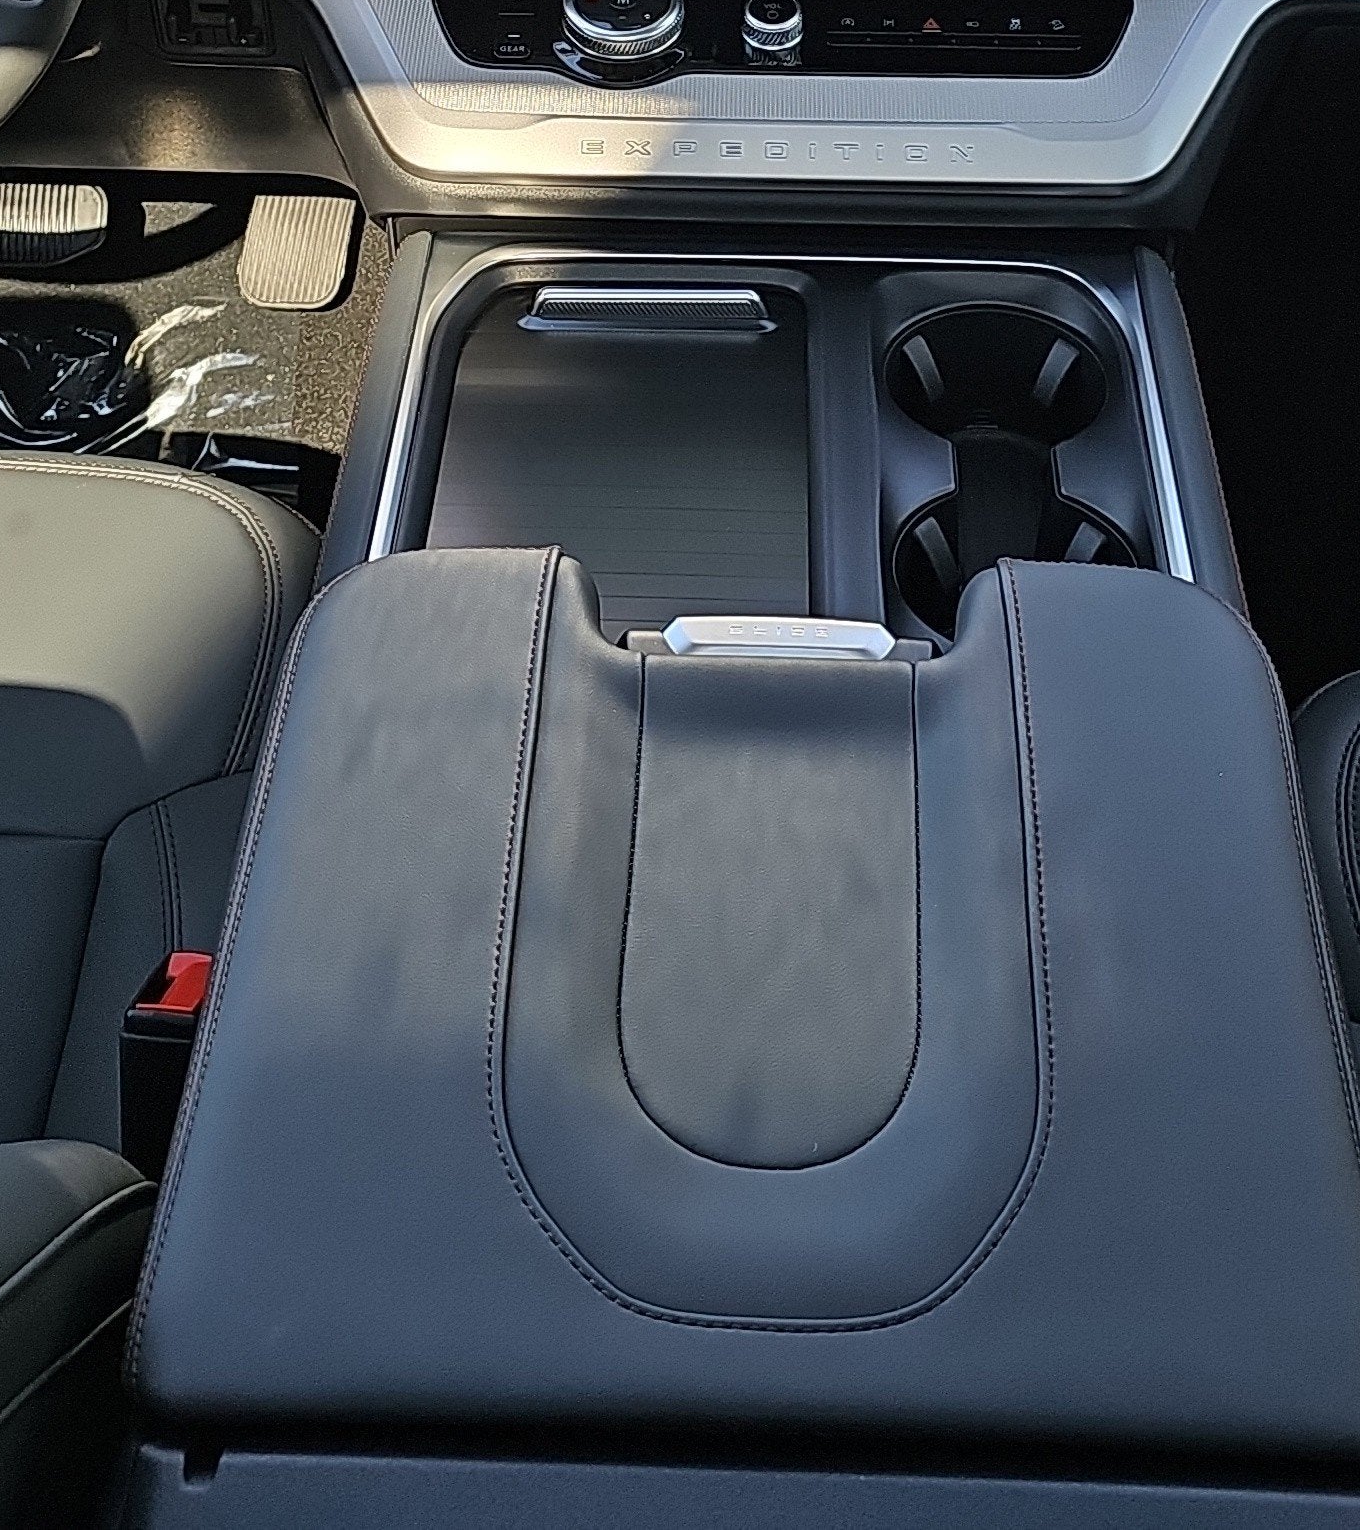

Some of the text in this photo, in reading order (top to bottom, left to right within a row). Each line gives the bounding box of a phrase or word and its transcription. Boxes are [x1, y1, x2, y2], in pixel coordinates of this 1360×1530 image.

[762, 2, 783, 10] VOL
[499, 45, 526, 53] GEAR
[579, 139, 976, 164] EXPEDITION
